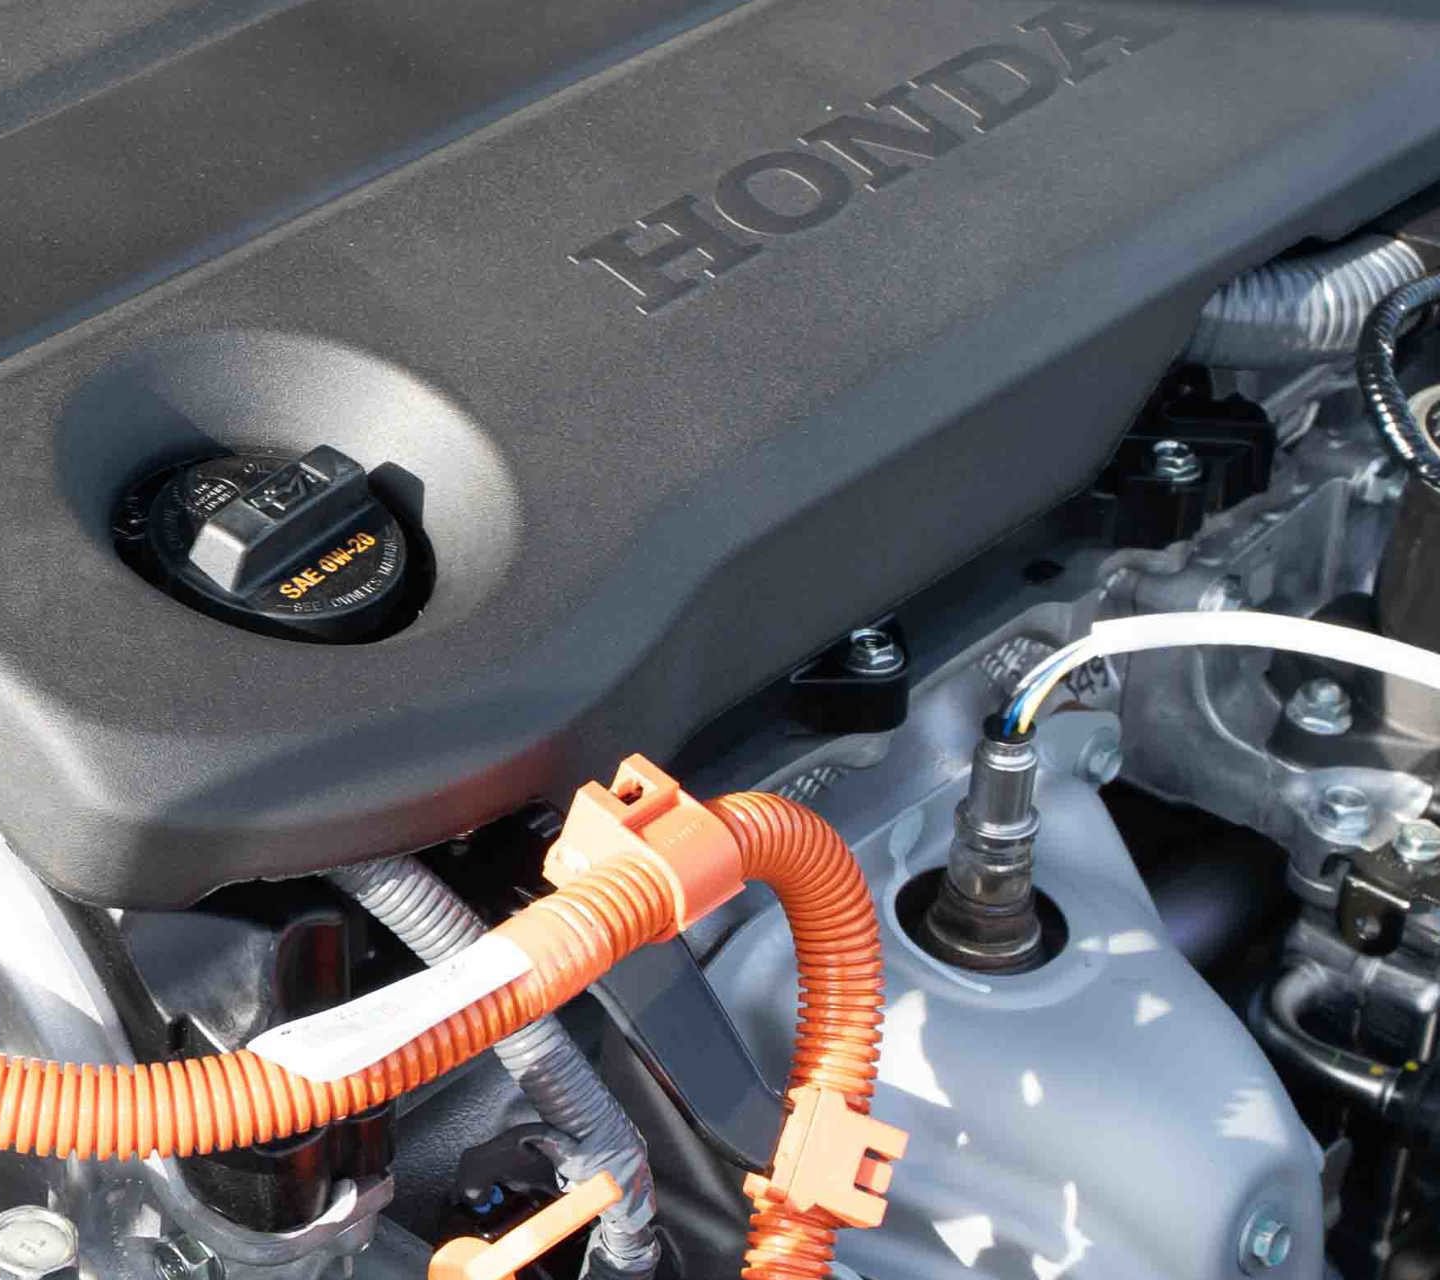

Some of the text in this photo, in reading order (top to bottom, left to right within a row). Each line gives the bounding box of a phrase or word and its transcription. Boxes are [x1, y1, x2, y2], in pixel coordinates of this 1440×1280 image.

[566, 3, 1176, 317] HONDA
[279, 532, 376, 600] SAE 0W-20
